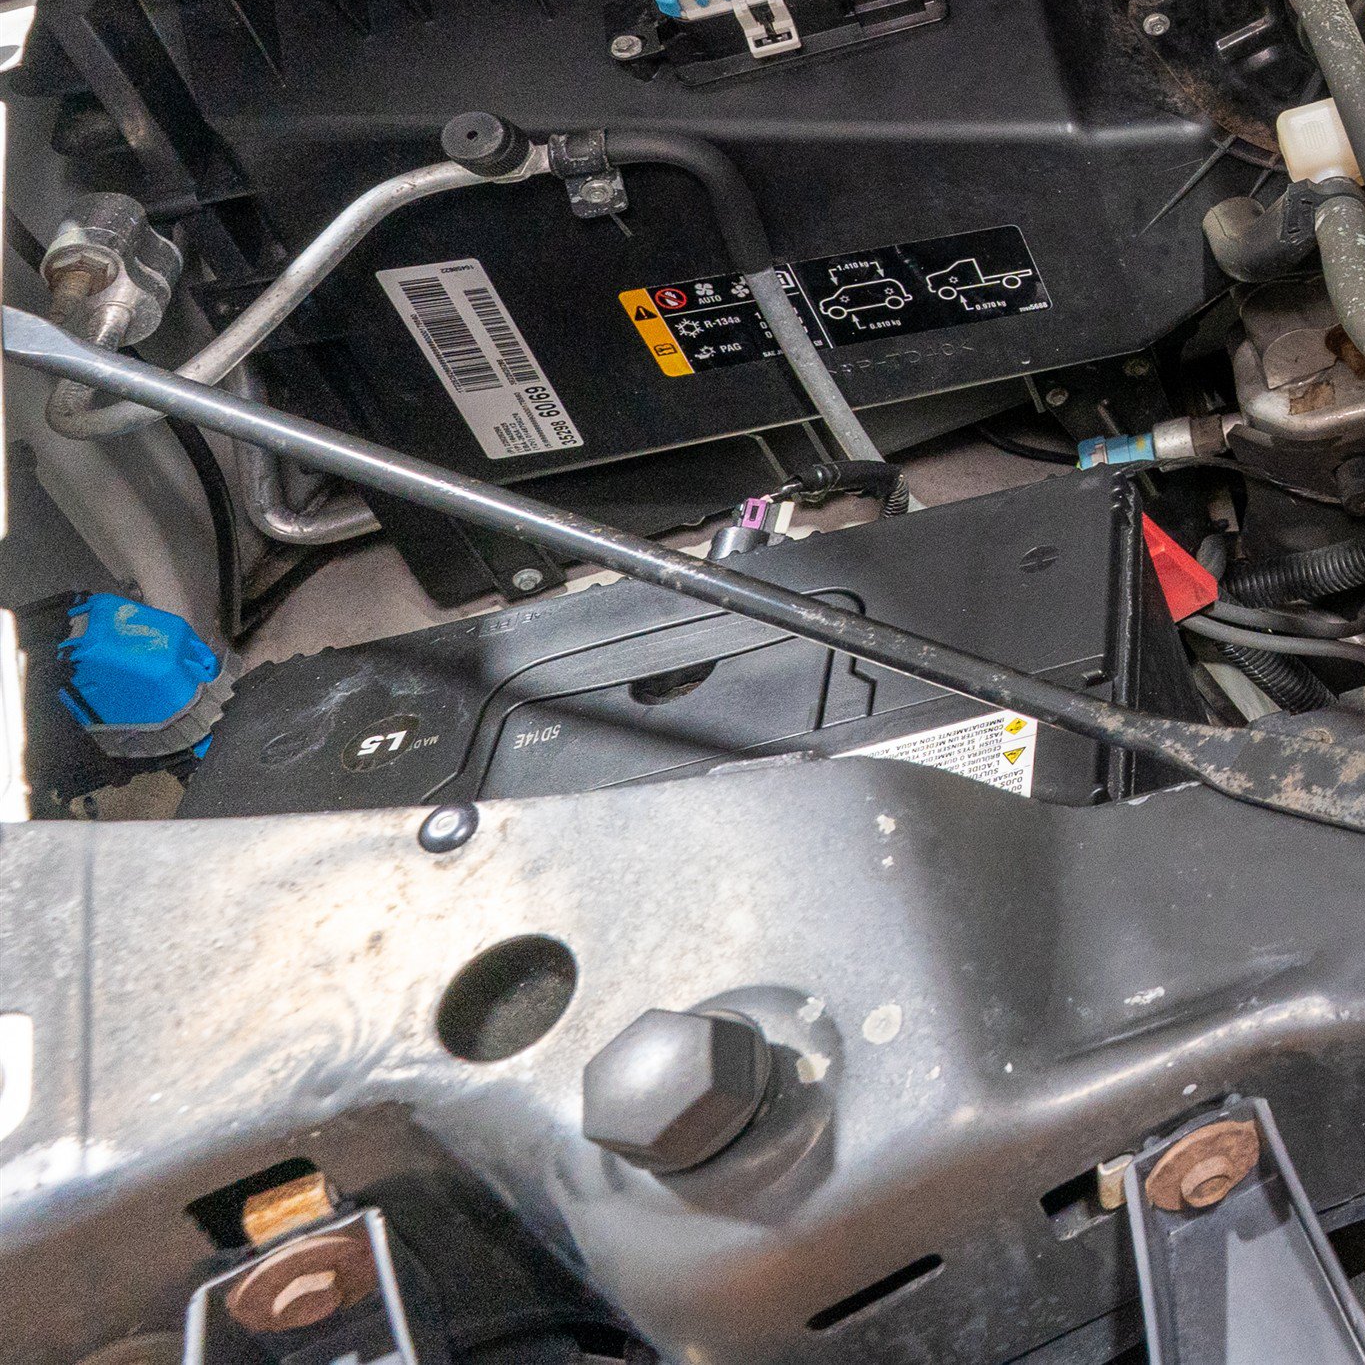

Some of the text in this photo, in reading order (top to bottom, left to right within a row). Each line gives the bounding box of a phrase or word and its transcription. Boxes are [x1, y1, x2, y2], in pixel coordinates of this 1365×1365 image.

[859, 260, 870, 268] kg
[698, 295, 722, 304] AUTO
[704, 316, 741, 329] R-134a
[720, 343, 742, 353] PAG
[525, 386, 560, 417] 60/69
[551, 420, 577, 445] 35298
[938, 717, 1004, 739] INMEDIATAMENTE
[960, 724, 1004, 740] CONSULTER
[357, 730, 407, 755] L5
[513, 724, 561, 749] 5D14E
[920, 736, 935, 744] CON
[948, 736, 959, 744] UN
[979, 737, 1002, 748] FLUSH
[896, 741, 917, 751] AGUA
[937, 741, 964, 753] RINSER
[957, 745, 975, 755] EYES
[923, 749, 934, 757] LES
[967, 760, 1000, 774] L'ACIDE
[993, 770, 1024, 782] CAUSAR
